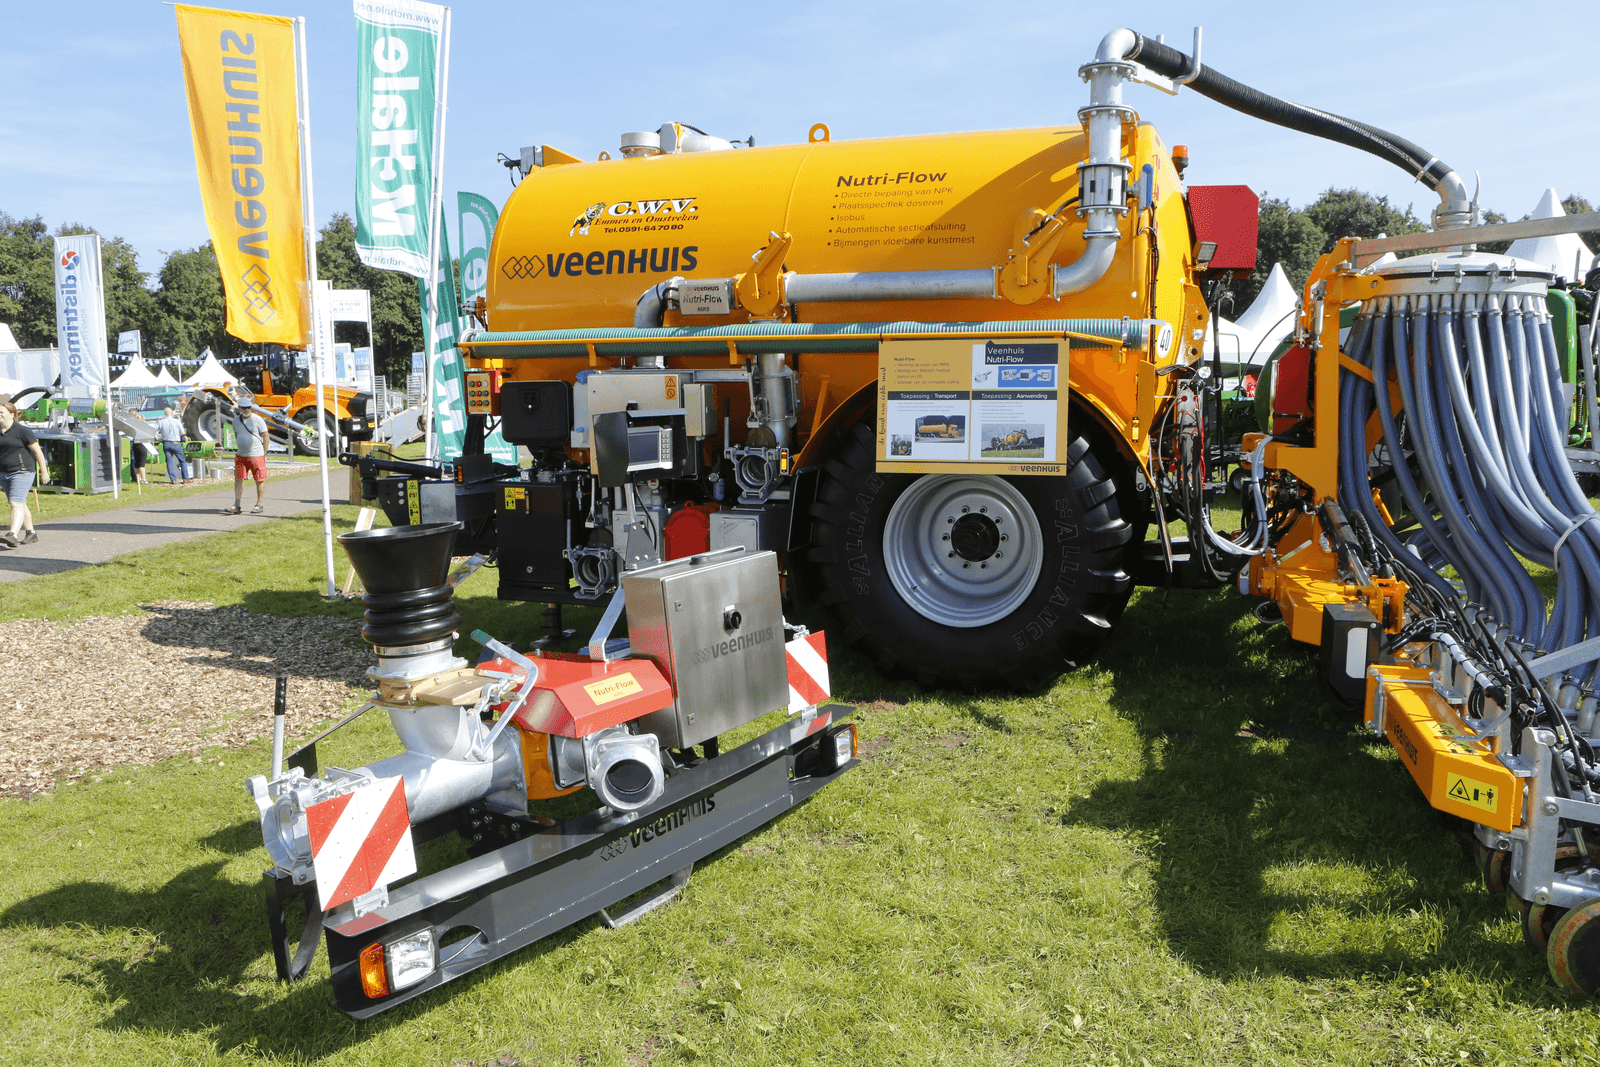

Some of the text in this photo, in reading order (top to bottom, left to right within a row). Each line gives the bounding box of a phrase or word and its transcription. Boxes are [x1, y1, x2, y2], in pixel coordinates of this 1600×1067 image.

[836, 171, 947, 187] Nutri-Flow
[841, 191, 872, 199] Directe
[874, 189, 913, 198] bepaling
[933, 187, 954, 195] NPK
[607, 197, 698, 217] C.W.V.
[838, 199, 943, 210] Plaatsspecifiek doseren
[594, 217, 629, 226] Emmen
[645, 214, 699, 223] Omstreken
[836, 214, 865, 222] Isobus
[835, 222, 966, 234] Automatische sectieafsluiting
[833, 236, 975, 248] Bijmengen vloeibare kunstmest
[683, 295, 723, 303] Nutri-Flow
[1160, 329, 1171, 351] 40
[987, 347, 1025, 355] Veenhuis
[986, 356, 1024, 364] Nutri-Flow
[1013, 519, 1080, 651] ALLIANCE
[593, 680, 634, 697] Nutri-Flow
